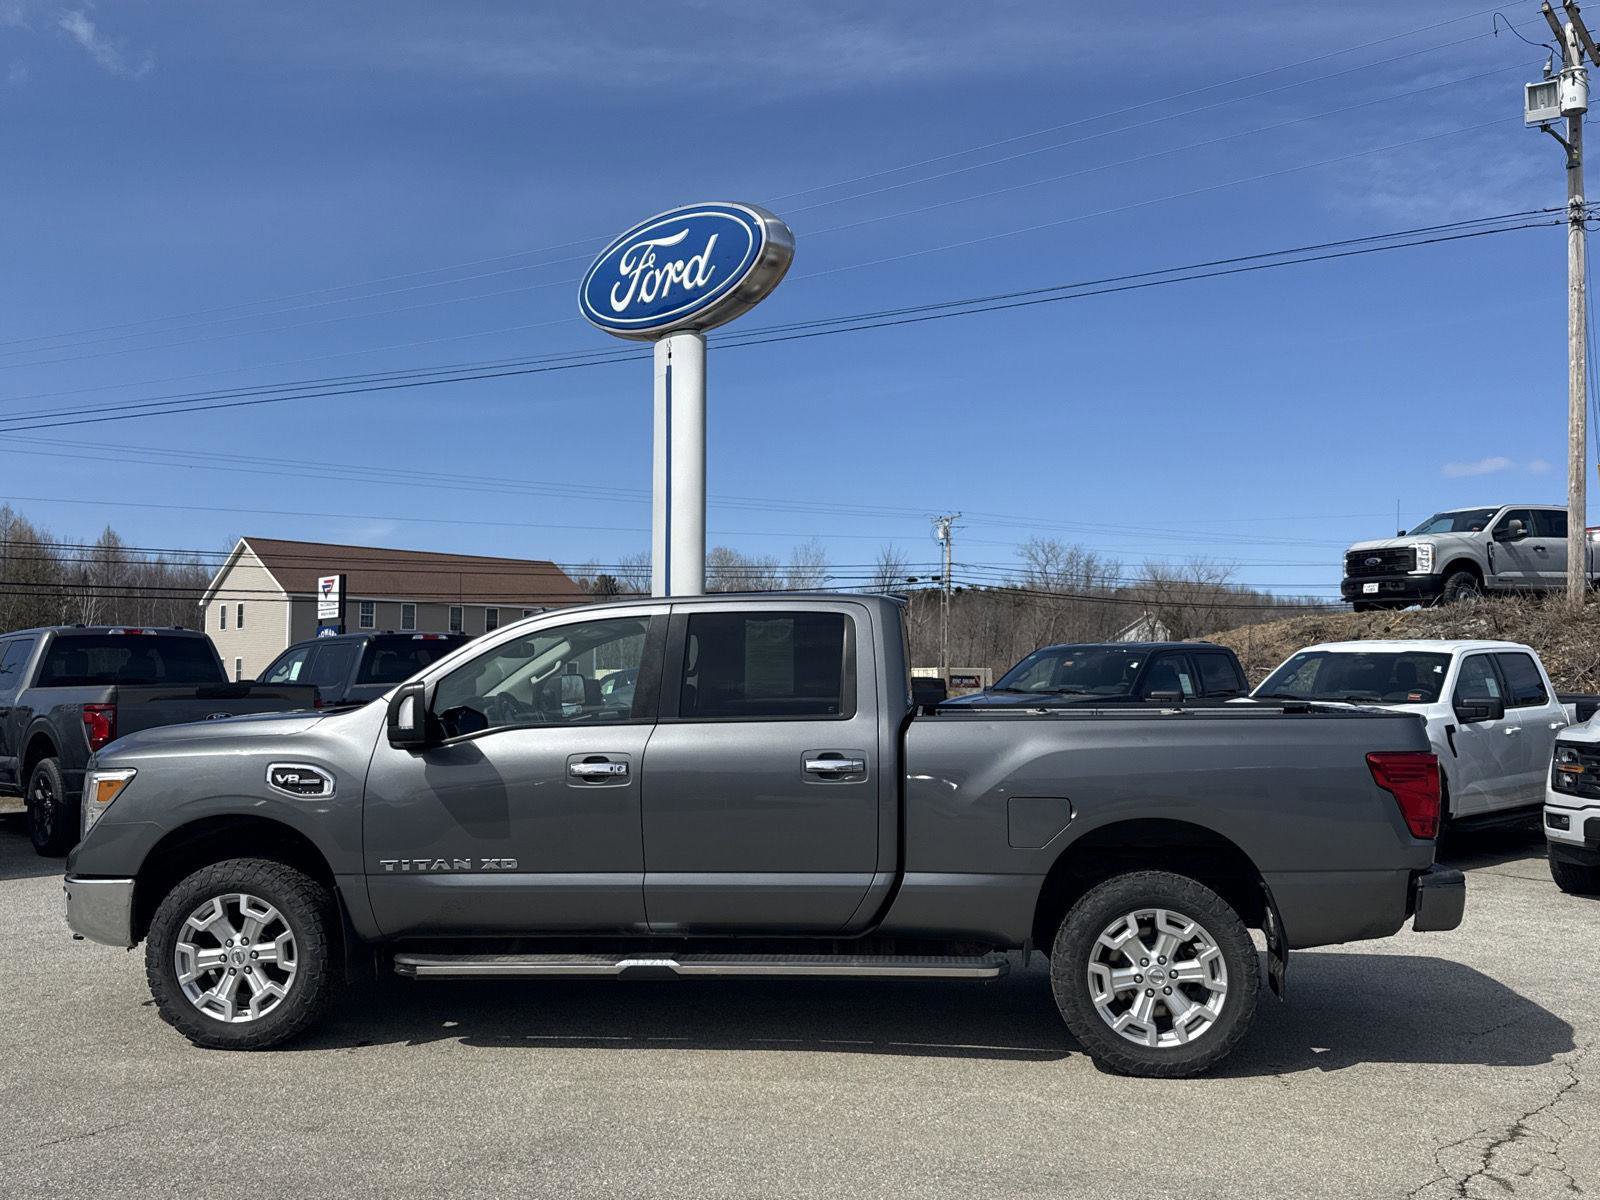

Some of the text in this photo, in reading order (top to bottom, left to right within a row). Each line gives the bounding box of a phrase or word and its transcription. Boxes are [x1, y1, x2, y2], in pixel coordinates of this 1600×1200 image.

[610, 228, 718, 312] Ford
[275, 774, 300, 784] V8
[379, 858, 518, 871] TITAN XD
